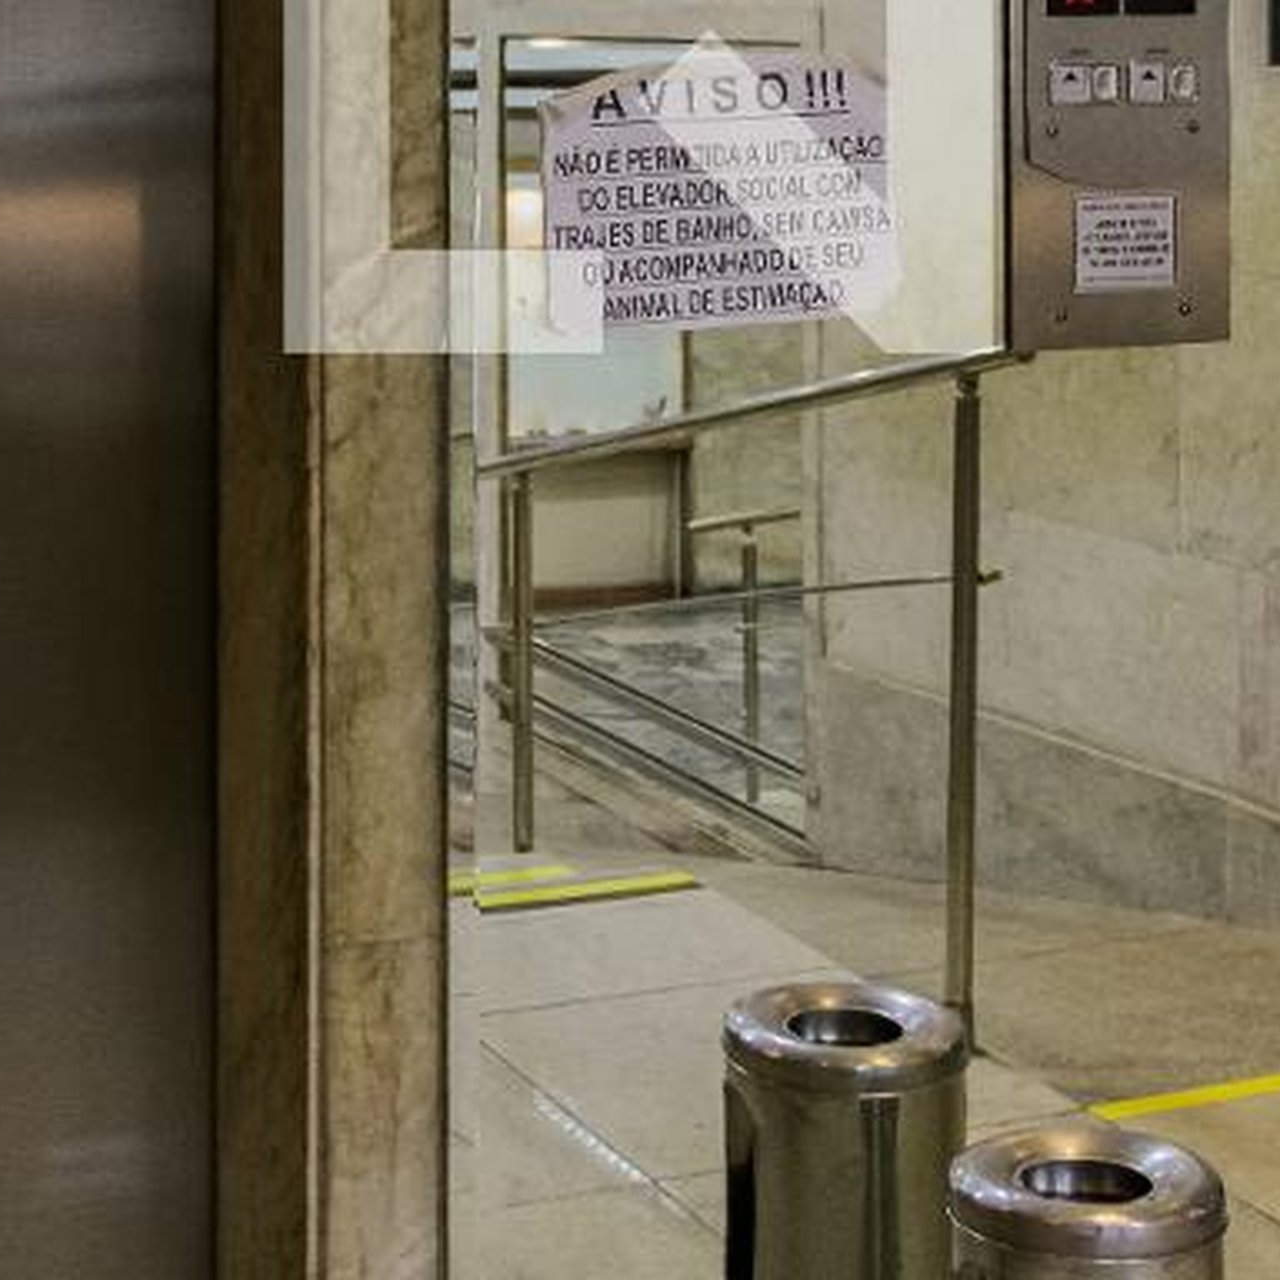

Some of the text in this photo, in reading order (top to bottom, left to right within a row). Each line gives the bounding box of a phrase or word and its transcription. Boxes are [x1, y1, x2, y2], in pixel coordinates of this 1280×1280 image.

[578, 186, 609, 212] DO
[616, 178, 736, 211] ELEVADOR
[737, 175, 812, 202] SOCIAL
[554, 220, 634, 250] TRAJES
[642, 218, 671, 245] DE
[619, 247, 784, 284] ACOMPANHADO
[821, 241, 864, 268] SEU
[602, 292, 682, 320] ANIMAL
[688, 287, 715, 315] DE
